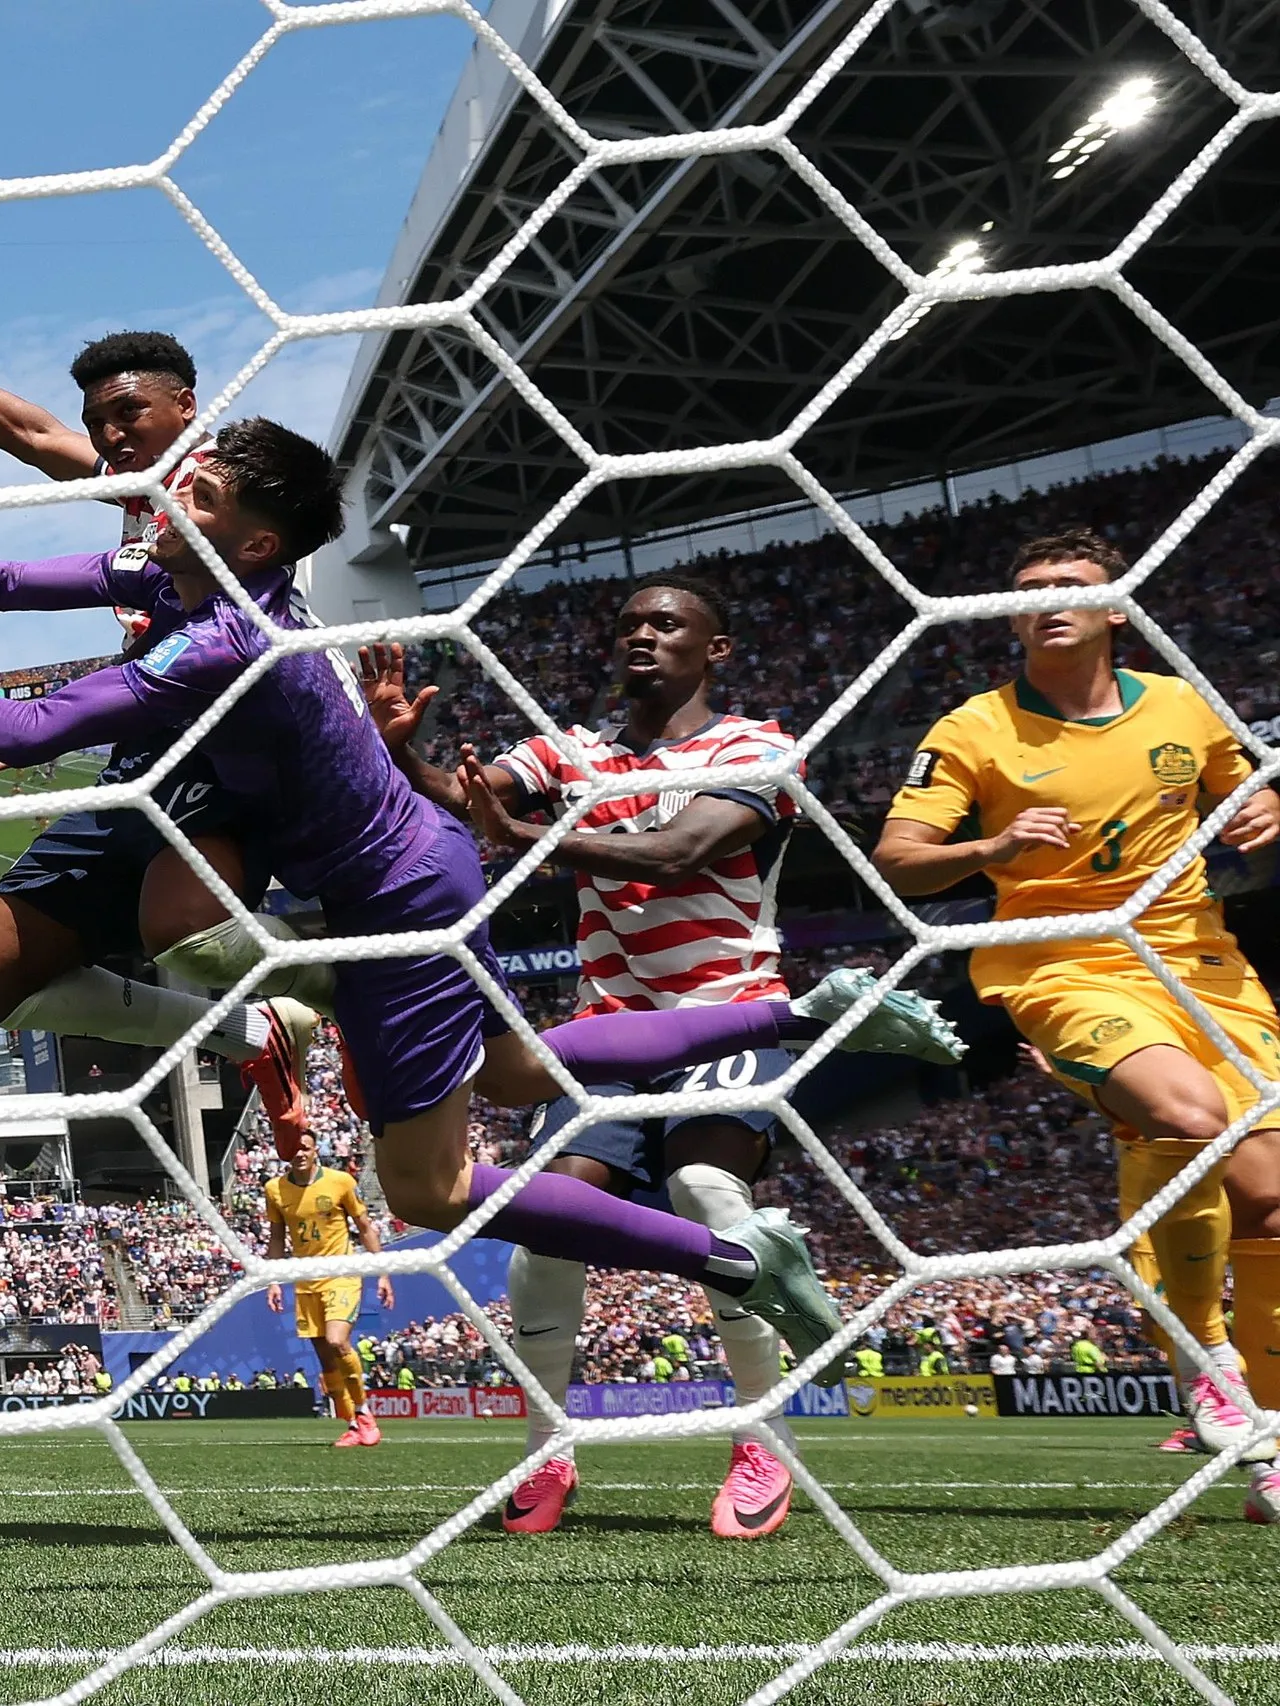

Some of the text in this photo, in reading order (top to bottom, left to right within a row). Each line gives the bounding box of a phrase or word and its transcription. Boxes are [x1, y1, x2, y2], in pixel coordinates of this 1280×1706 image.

[10, 686, 32, 699] AUS
[1091, 820, 1129, 873] 3
[682, 1049, 758, 1094] 20
[299, 1220, 321, 1243] 24
[328, 1290, 350, 1308] 24
[799, 1384, 849, 1415] VISA
[1013, 1375, 1181, 1415] MARRIOTT
